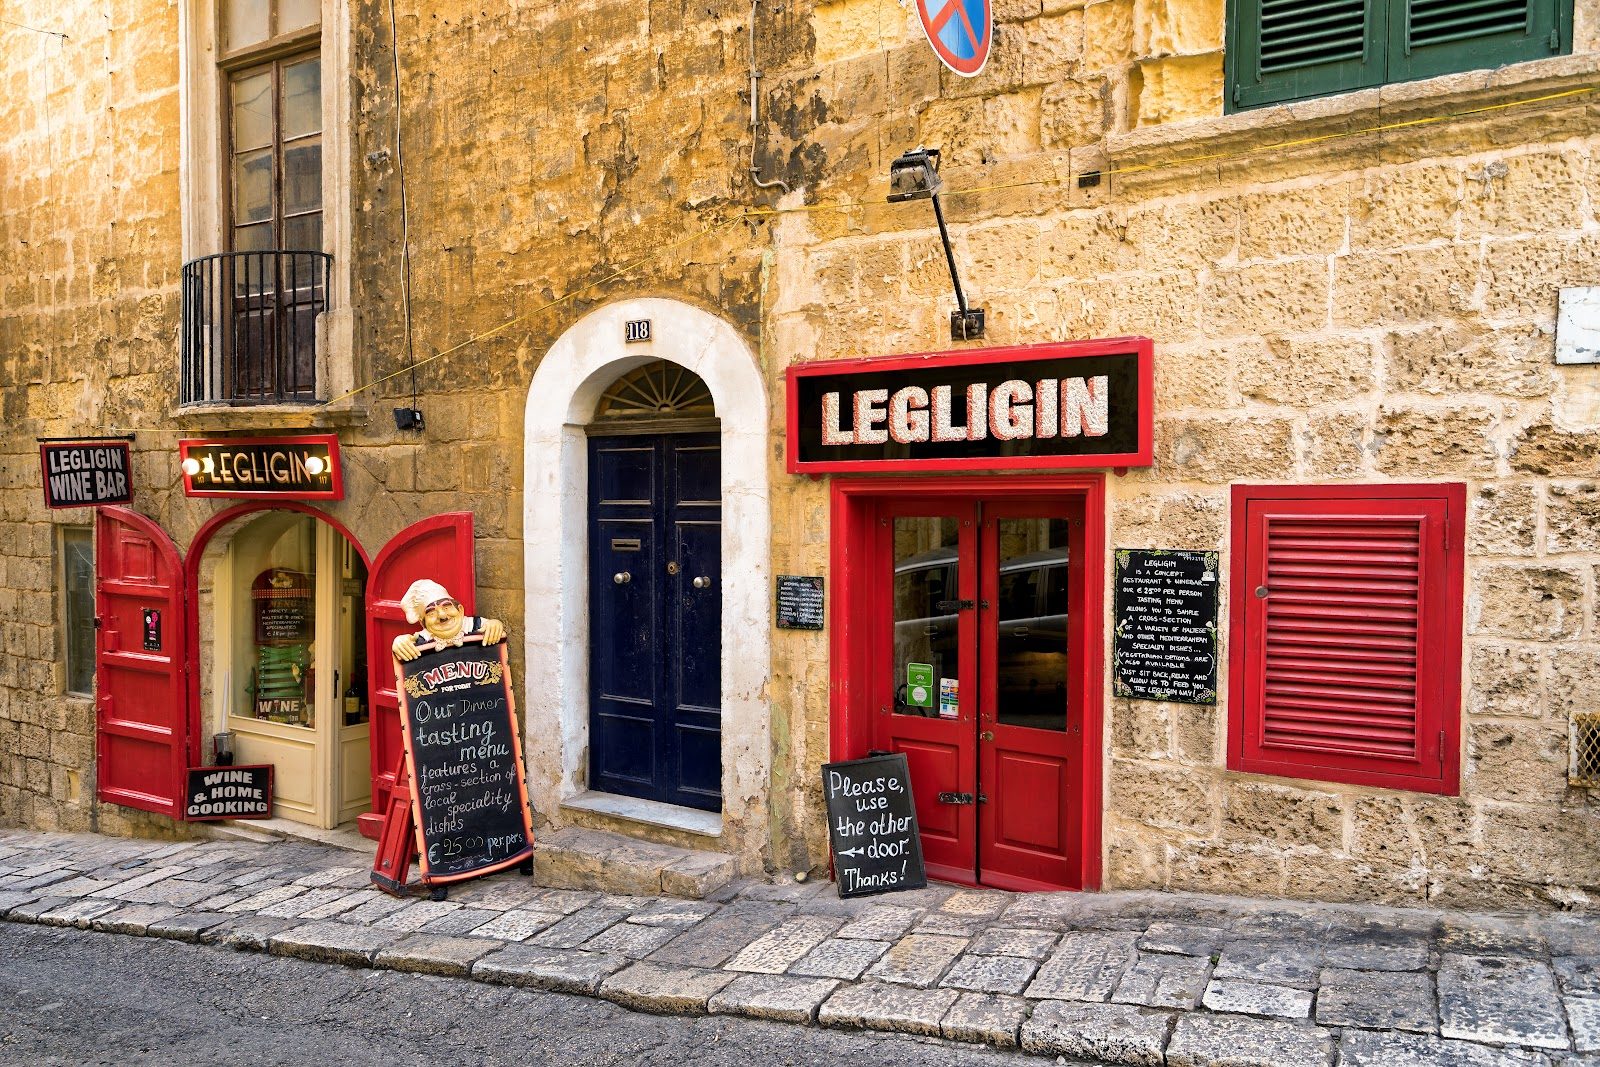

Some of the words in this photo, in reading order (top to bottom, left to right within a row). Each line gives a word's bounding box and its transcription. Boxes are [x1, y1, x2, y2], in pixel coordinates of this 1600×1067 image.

[628, 321, 648, 340] 118
[821, 375, 1109, 446] LEGLIGIN
[49, 448, 123, 474] LEGLIGIN
[208, 450, 312, 484] LEGLIGIN
[50, 471, 93, 501] WINE
[95, 470, 128, 500] BAR
[1144, 560, 1177, 568] LEGLIGIN
[1154, 569, 1185, 577] CONCEPT
[1122, 577, 1162, 585] RESTAURANT
[1137, 596, 1162, 605] TASTING
[1178, 589, 1203, 597] PERSON
[1151, 606, 1161, 614] YOU
[1144, 625, 1169, 633] VARIETY
[1159, 635, 1208, 644] MEDITERRANEAN
[423, 661, 488, 690] MENU
[1120, 667, 1137, 676] JUST
[1171, 672, 1190, 680] RELAX
[441, 684, 455, 693] FOR
[455, 682, 472, 691] TODAY
[1133, 685, 1146, 693] THE
[1147, 687, 1177, 697] LEGLIGIN
[1192, 682, 1205, 690] YOU
[416, 700, 456, 724] Our
[460, 698, 505, 717] Dinner
[416, 721, 496, 747] tasting
[460, 744, 510, 762] menu
[204, 771, 252, 786] WINE
[420, 761, 478, 790] features
[490, 760, 500, 769] a
[505, 763, 517, 785] of
[830, 771, 904, 799] Please,
[194, 793, 207, 803] &
[211, 786, 262, 799] HOME
[424, 791, 457, 810] local
[188, 801, 267, 815] COOKING
[447, 788, 513, 821] speciality
[856, 797, 888, 812] use
[425, 816, 464, 836] dishes
[836, 816, 865, 837] the
[869, 813, 913, 836] other
[428, 843, 441, 866] €
[844, 860, 907, 892] Thanks!
